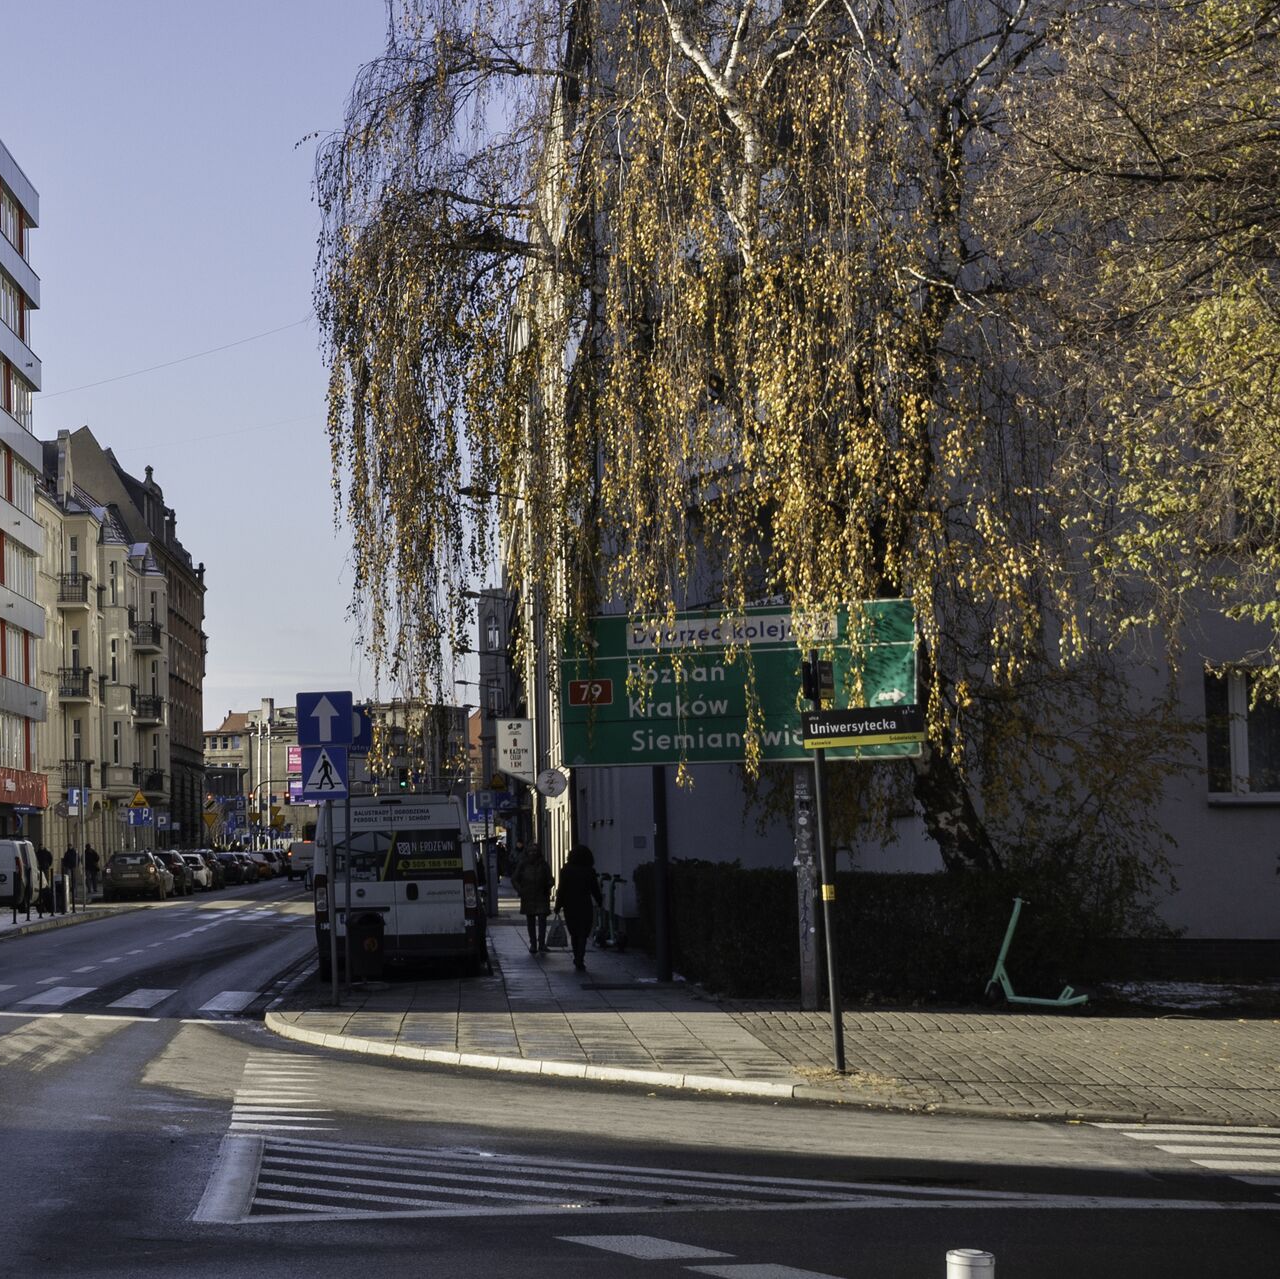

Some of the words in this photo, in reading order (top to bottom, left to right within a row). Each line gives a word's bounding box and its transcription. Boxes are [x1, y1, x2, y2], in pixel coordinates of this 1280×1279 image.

[627, 660, 725, 685] Poznań
[579, 683, 603, 702] 79
[628, 694, 729, 718] Kraków
[810, 718, 897, 735] Uniwersytecka
